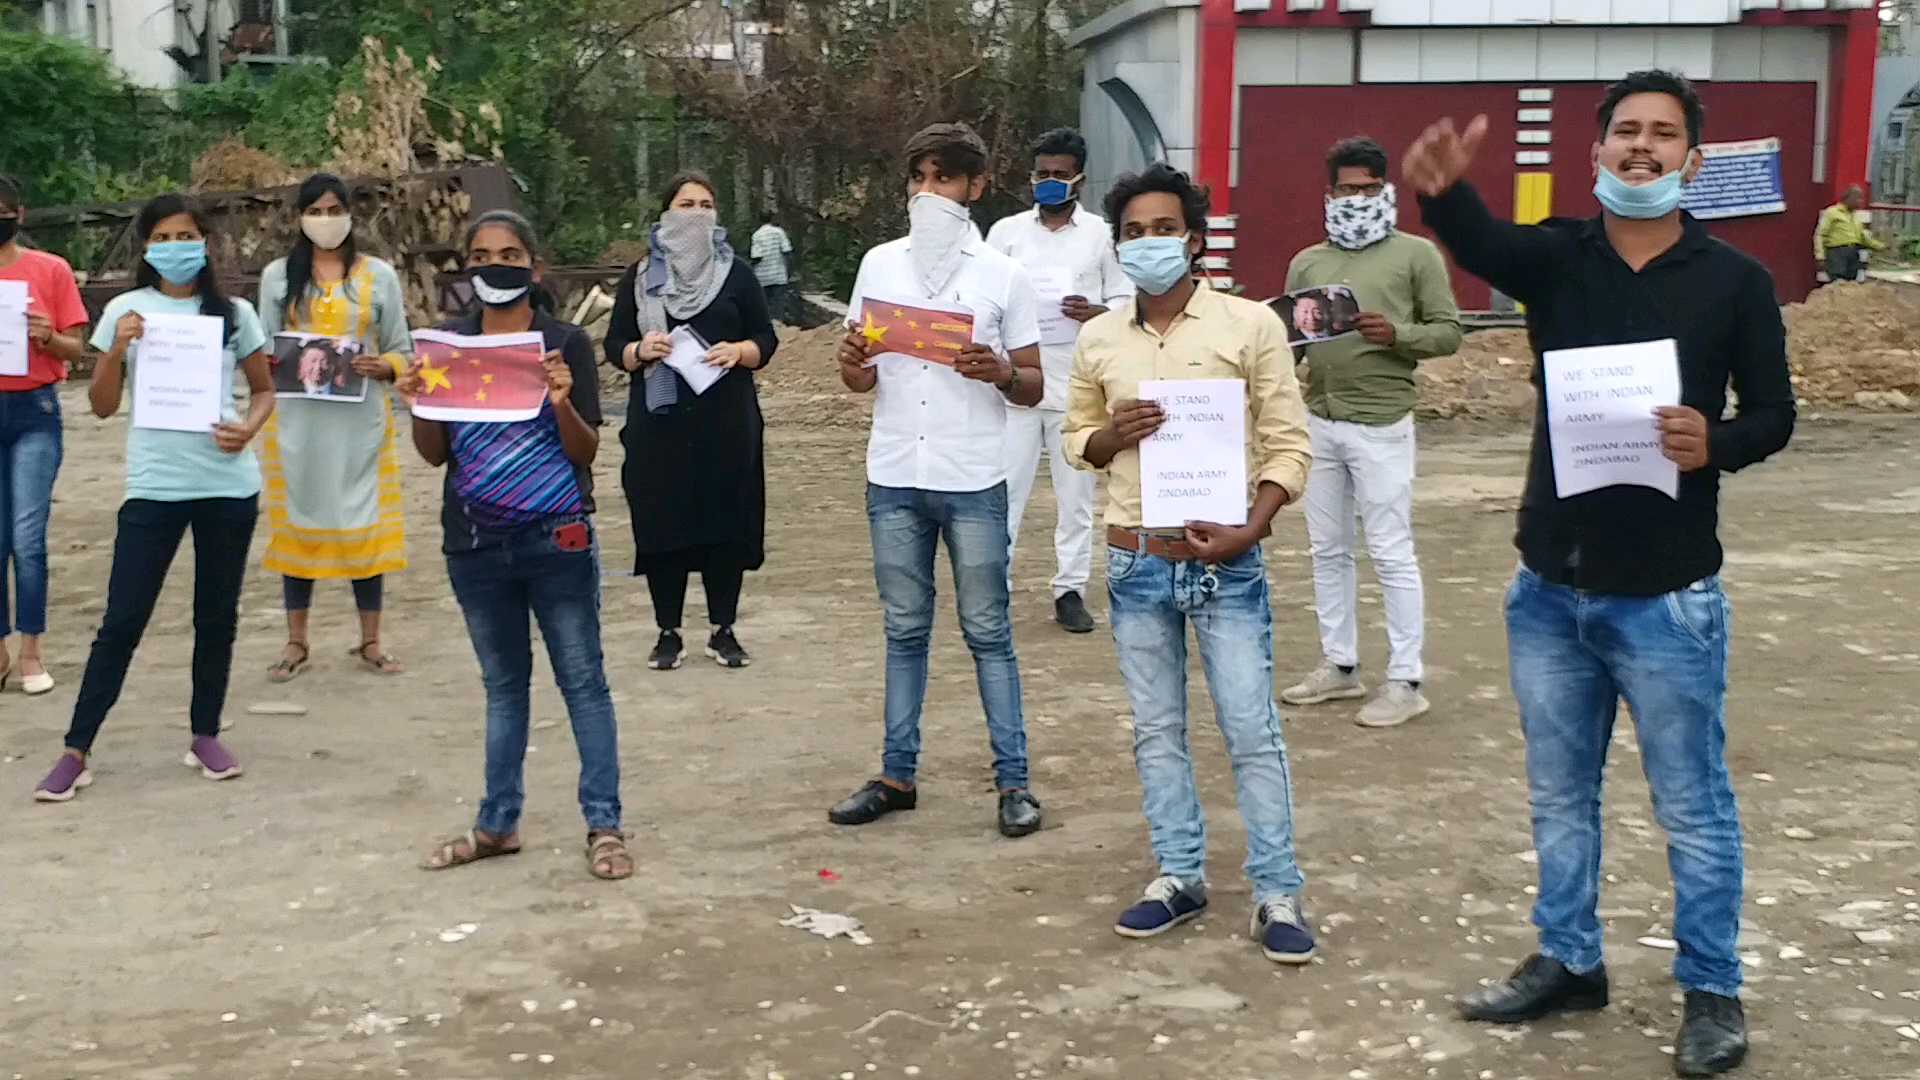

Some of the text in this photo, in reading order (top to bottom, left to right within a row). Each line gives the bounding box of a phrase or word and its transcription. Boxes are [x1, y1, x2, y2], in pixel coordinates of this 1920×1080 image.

[1563, 366, 1634, 381] WE STAND
[1563, 385, 1654, 402] WITH INDIAN
[1175, 395, 1211, 405] STAND
[1188, 412, 1225, 423] INDIAN
[1565, 413, 1604, 424] ARMY
[1152, 432, 1184, 442] ARMY
[1571, 442, 1619, 454] INDIAN
[1157, 470, 1228, 481] INDIAN ARMY
[1158, 487, 1212, 498] ZINDABAD
